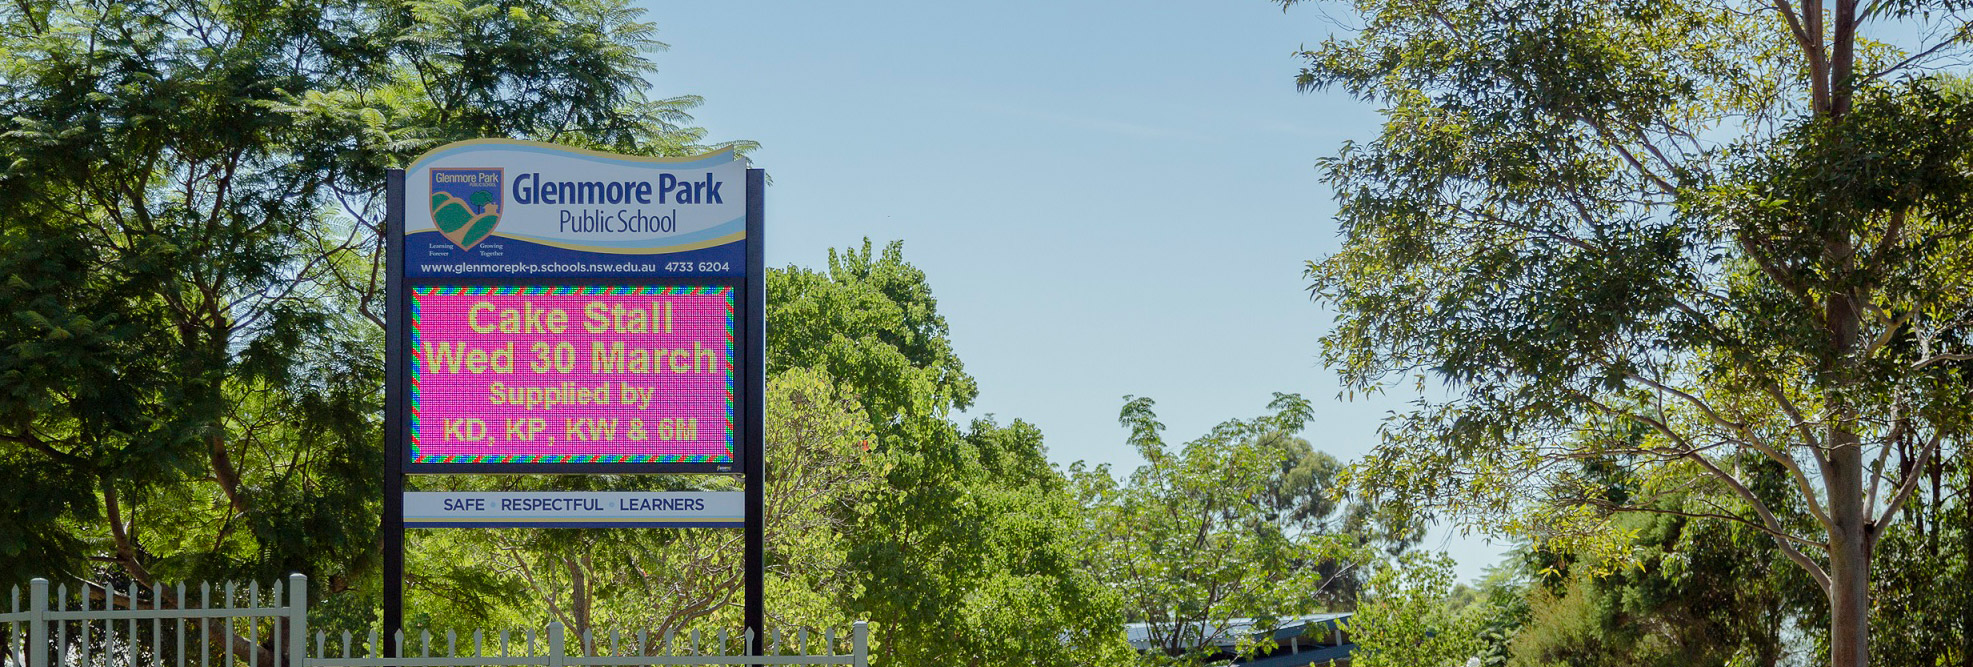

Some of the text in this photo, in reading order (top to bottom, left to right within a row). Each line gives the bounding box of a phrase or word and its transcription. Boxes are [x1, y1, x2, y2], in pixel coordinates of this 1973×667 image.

[435, 172, 499, 183] Glenmore Park
[512, 172, 724, 205] Glenmore Park
[560, 209, 676, 233] Public School
[479, 250, 504, 258] Together
[421, 261, 656, 274] www.glenmorepk-p.schools.nsw.edu.au
[665, 262, 730, 273] 4733 6204
[467, 302, 673, 334] Cake Stall
[424, 341, 718, 374] Wed 30 March
[489, 382, 655, 410] Supplied by
[442, 418, 697, 446] KD, KP, KW & 6M
[443, 498, 705, 511] SAFE RESPECTFUL LEARNERS
